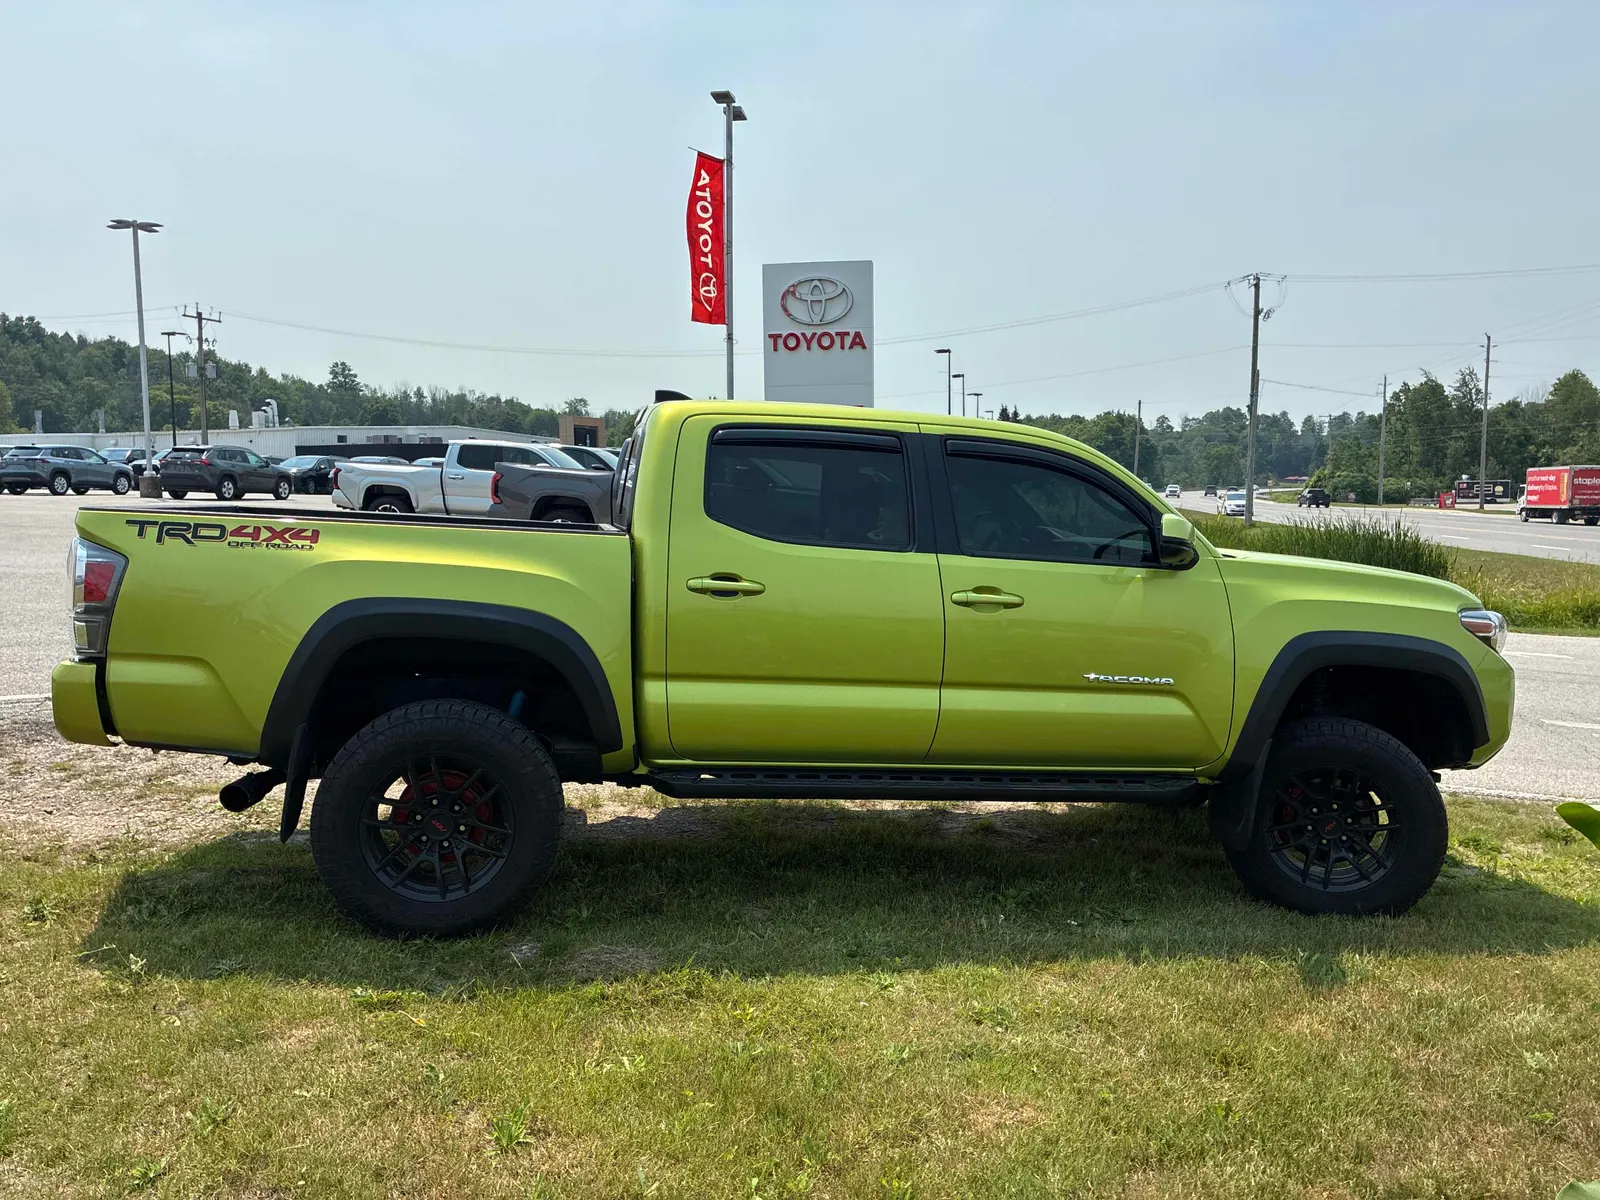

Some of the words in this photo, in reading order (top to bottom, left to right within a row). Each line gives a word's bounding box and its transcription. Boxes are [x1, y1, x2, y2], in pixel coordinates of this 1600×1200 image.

[768, 331, 867, 351] TOYOTA
[125, 519, 228, 547] TRD
[265, 542, 314, 551] ROAD
